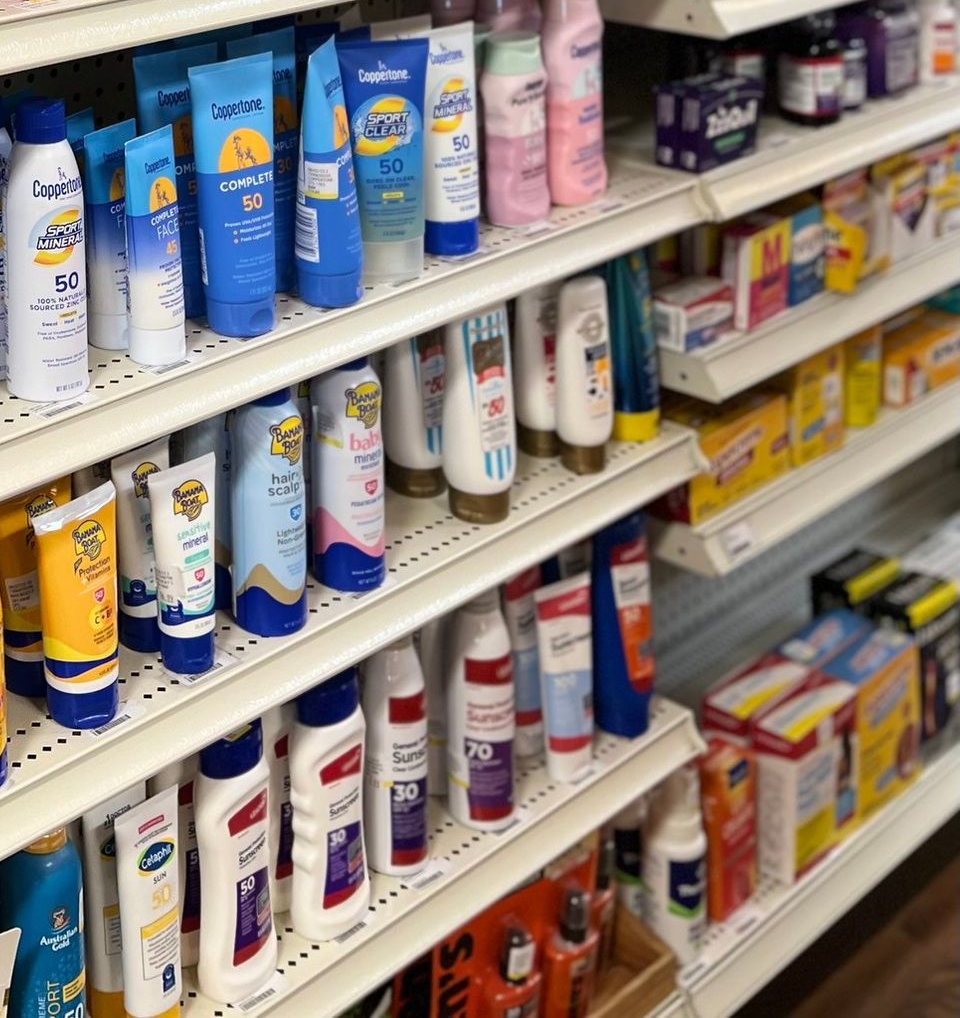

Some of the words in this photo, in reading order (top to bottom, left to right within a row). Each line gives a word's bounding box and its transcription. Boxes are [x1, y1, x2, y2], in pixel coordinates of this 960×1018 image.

[212, 98, 262, 122] Coppertone
[366, 112, 409, 126] SPORT
[364, 124, 407, 138] CLEAR
[452, 135, 470, 151] 50
[379, 158, 404, 175] 50
[220, 171, 273, 193] COMPLETE
[242, 193, 262, 212] 50
[55, 272, 79, 292] 50
[272, 470, 296, 485] hair
[268, 481, 300, 498] scalp
[182, 534, 208, 550] mineral
[465, 742, 493, 761] 70
[393, 782, 419, 802] 30
[141, 847, 174, 871] Cetaphil
[153, 872, 167, 884] SUN
[240, 877, 255, 896] 50
[40, 926, 78, 949] Australian
[52, 939, 70, 952] Gold
